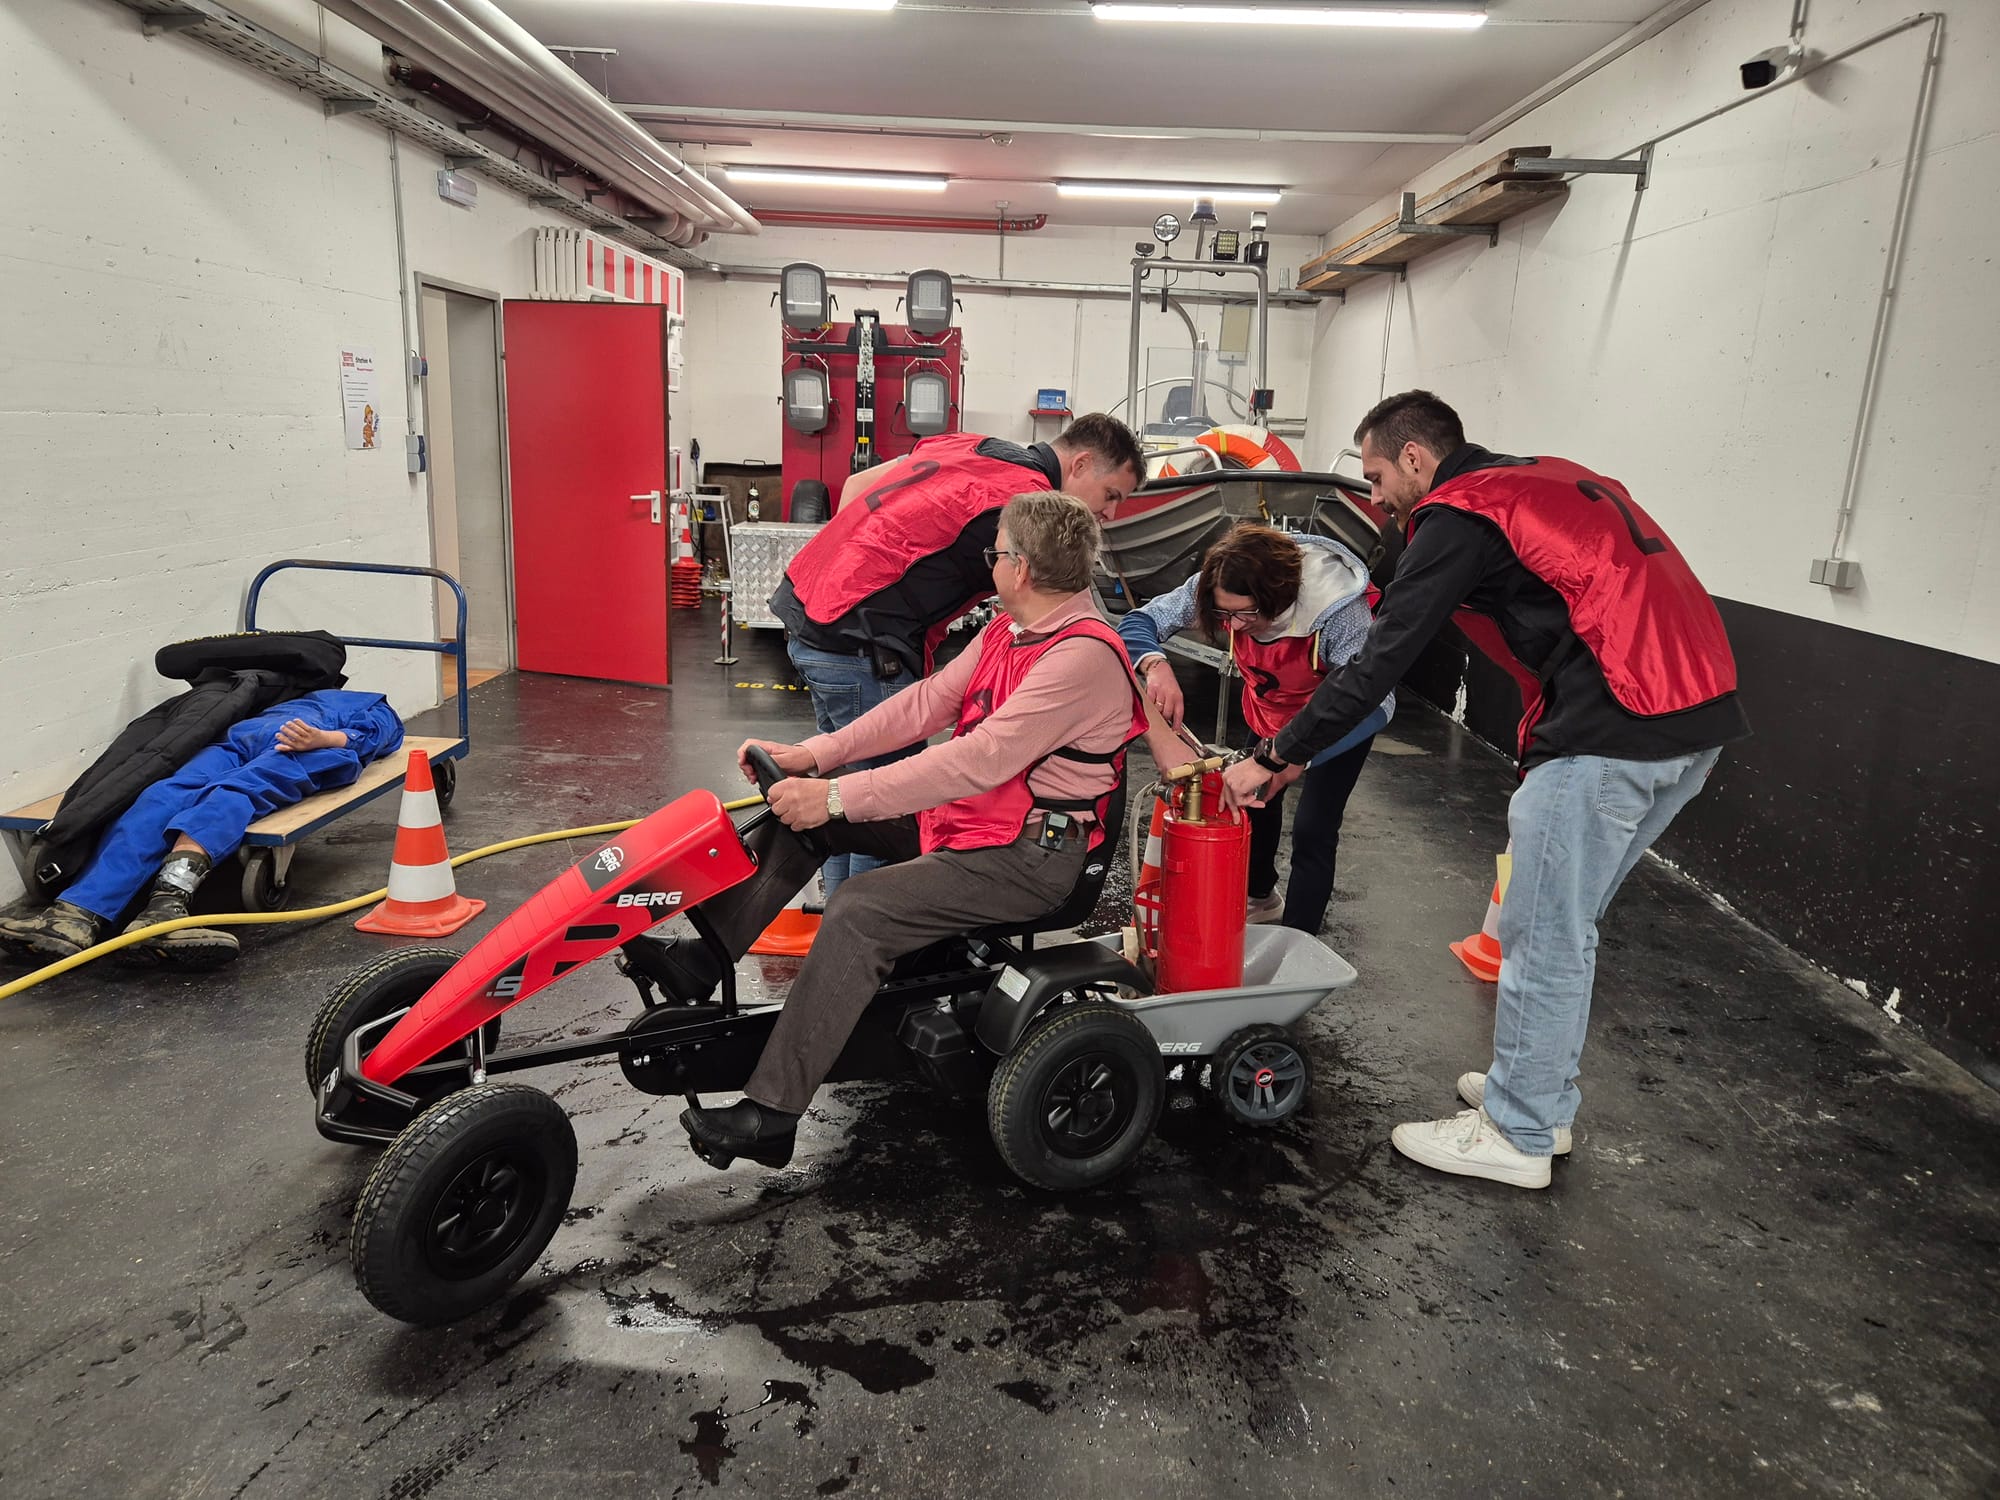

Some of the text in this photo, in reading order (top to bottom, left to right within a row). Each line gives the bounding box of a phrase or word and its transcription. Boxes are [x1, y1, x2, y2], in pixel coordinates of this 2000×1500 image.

[865, 460, 941, 513] 2
[1576, 479, 1668, 556] 2
[599, 847, 621, 872] BERG
[616, 891, 683, 908] BERG
[1157, 1042, 1203, 1053] ERG
